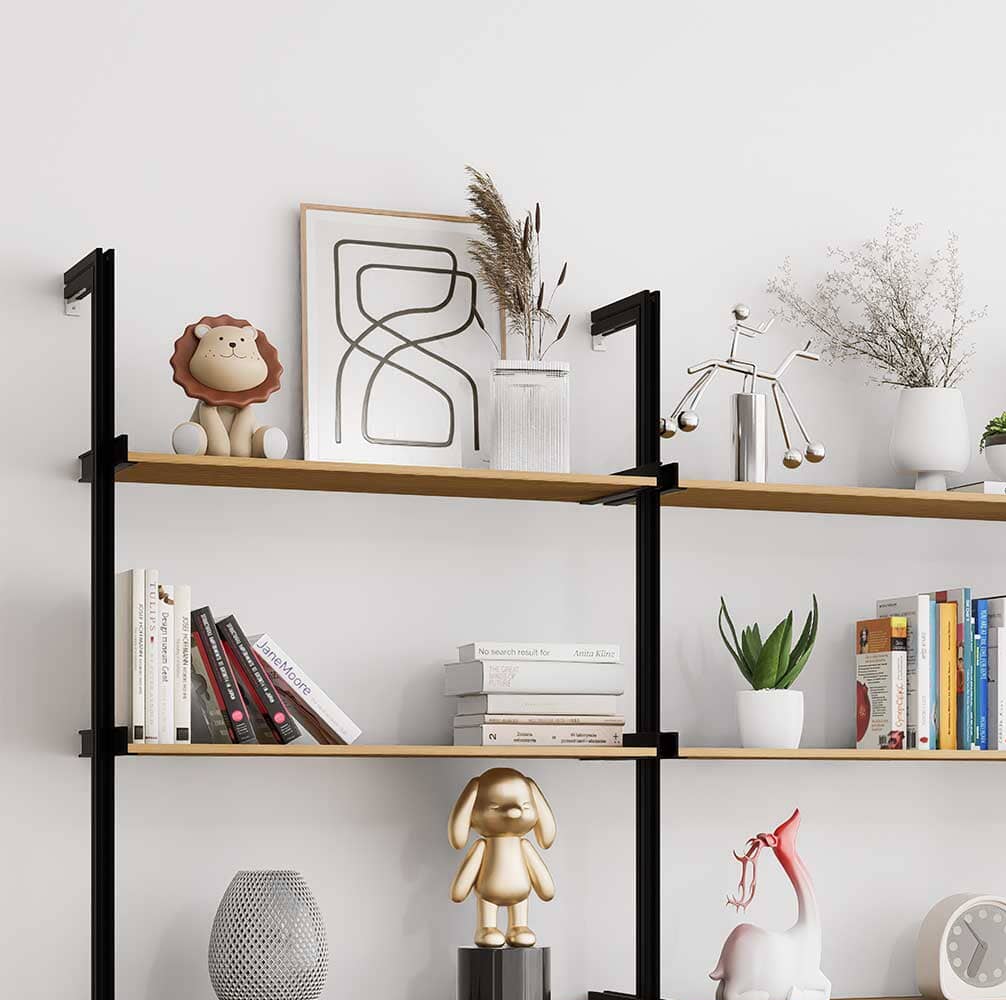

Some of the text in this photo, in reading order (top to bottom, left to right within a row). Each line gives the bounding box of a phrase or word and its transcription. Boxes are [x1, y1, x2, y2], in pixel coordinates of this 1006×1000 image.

[160, 612, 169, 636] Design
[478, 647, 551, 656] No search result for
[256, 641, 312, 696] JaneMoore
[488, 732, 497, 741] 2
